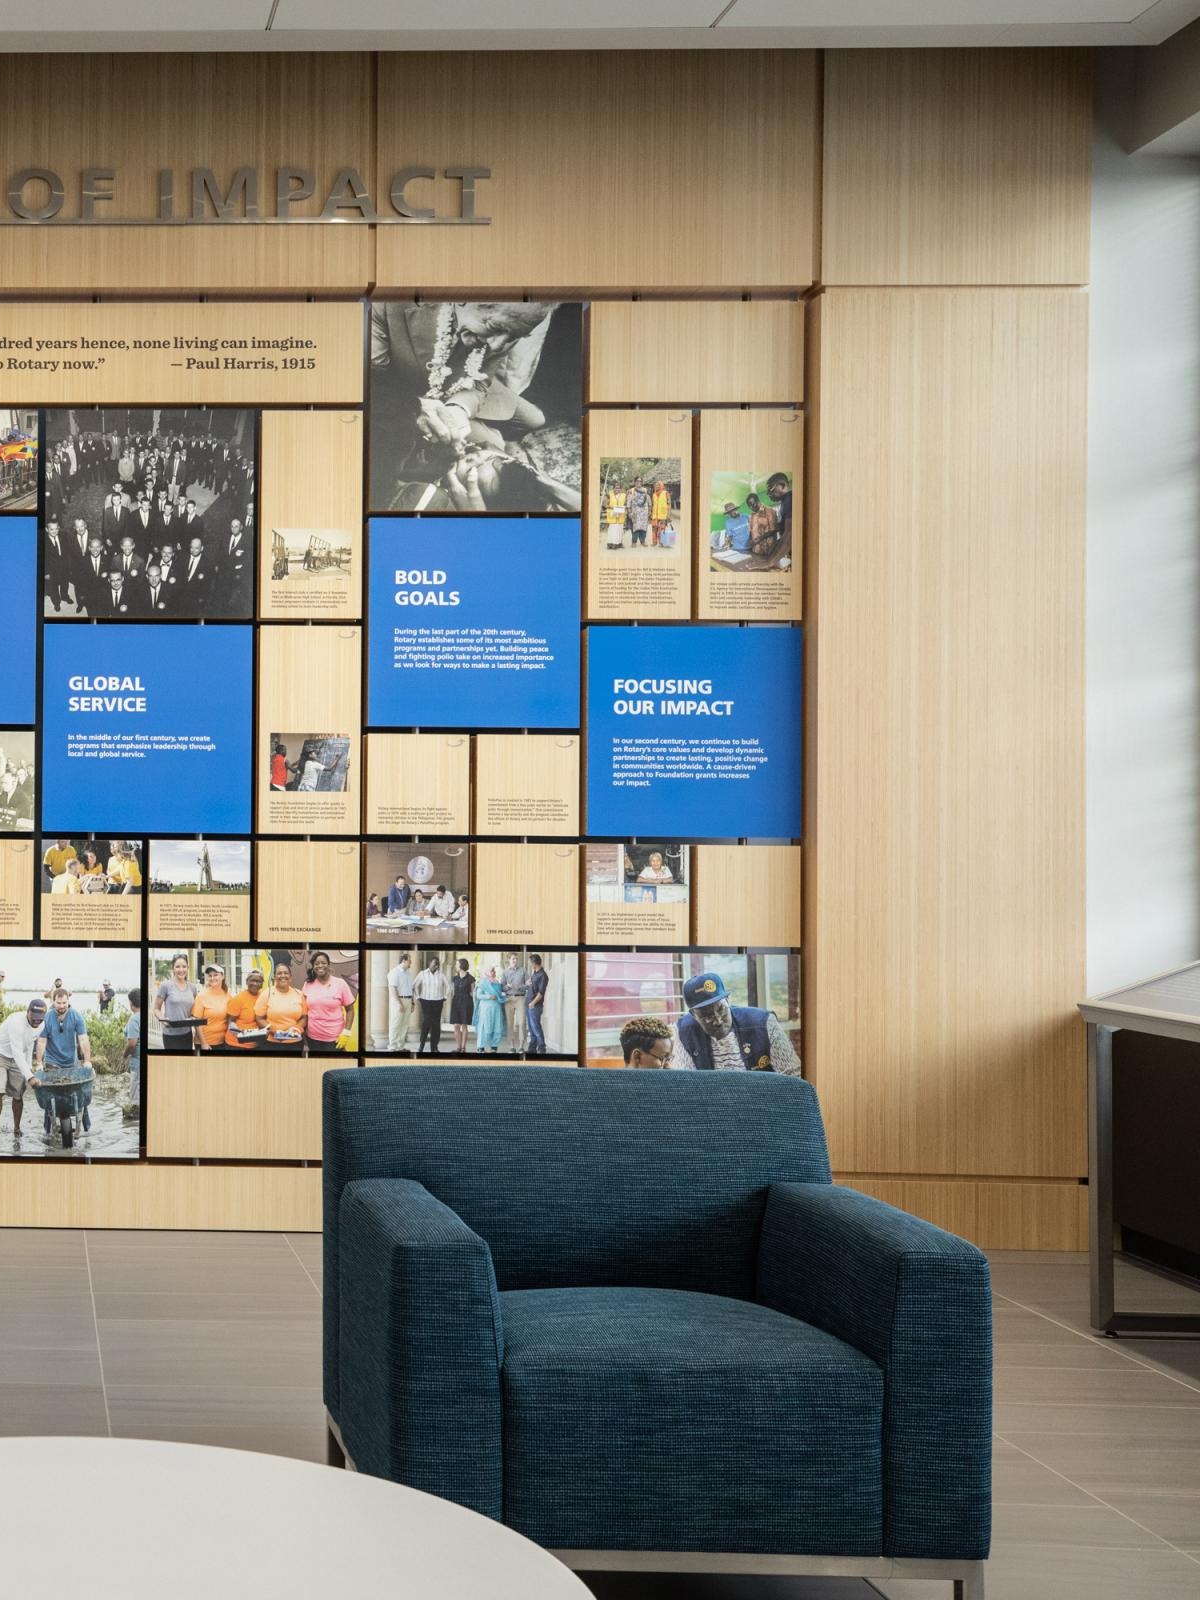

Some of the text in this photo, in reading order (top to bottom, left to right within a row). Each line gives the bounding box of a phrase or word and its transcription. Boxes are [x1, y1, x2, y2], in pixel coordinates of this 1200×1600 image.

[8, 167, 116, 220] OF
[159, 167, 492, 222] IMPACT
[36, 340, 77, 351] years
[81, 337, 129, 350] hence,
[133, 340, 170, 348] none
[174, 337, 218, 351] living
[221, 340, 248, 348] can
[252, 336, 316, 351] imagine.
[7, 358, 60, 372] Rotary
[63, 358, 105, 369] now.”
[186, 357, 220, 369] Paul
[224, 357, 278, 371] Harris,
[282, 358, 315, 369] 1915
[396, 570, 446, 584] BOLD
[395, 591, 460, 606] GOALS
[394, 628, 418, 637] During
[69, 676, 145, 691] GLOBAL
[614, 679, 712, 694] FOCUSING
[69, 697, 146, 712] SERVICE
[614, 700, 734, 715] OUR IMPACT
[116, 742, 152, 751] emphasize
[152, 743, 188, 751] leadership
[188, 743, 216, 751] through
[98, 751, 120, 759] global
